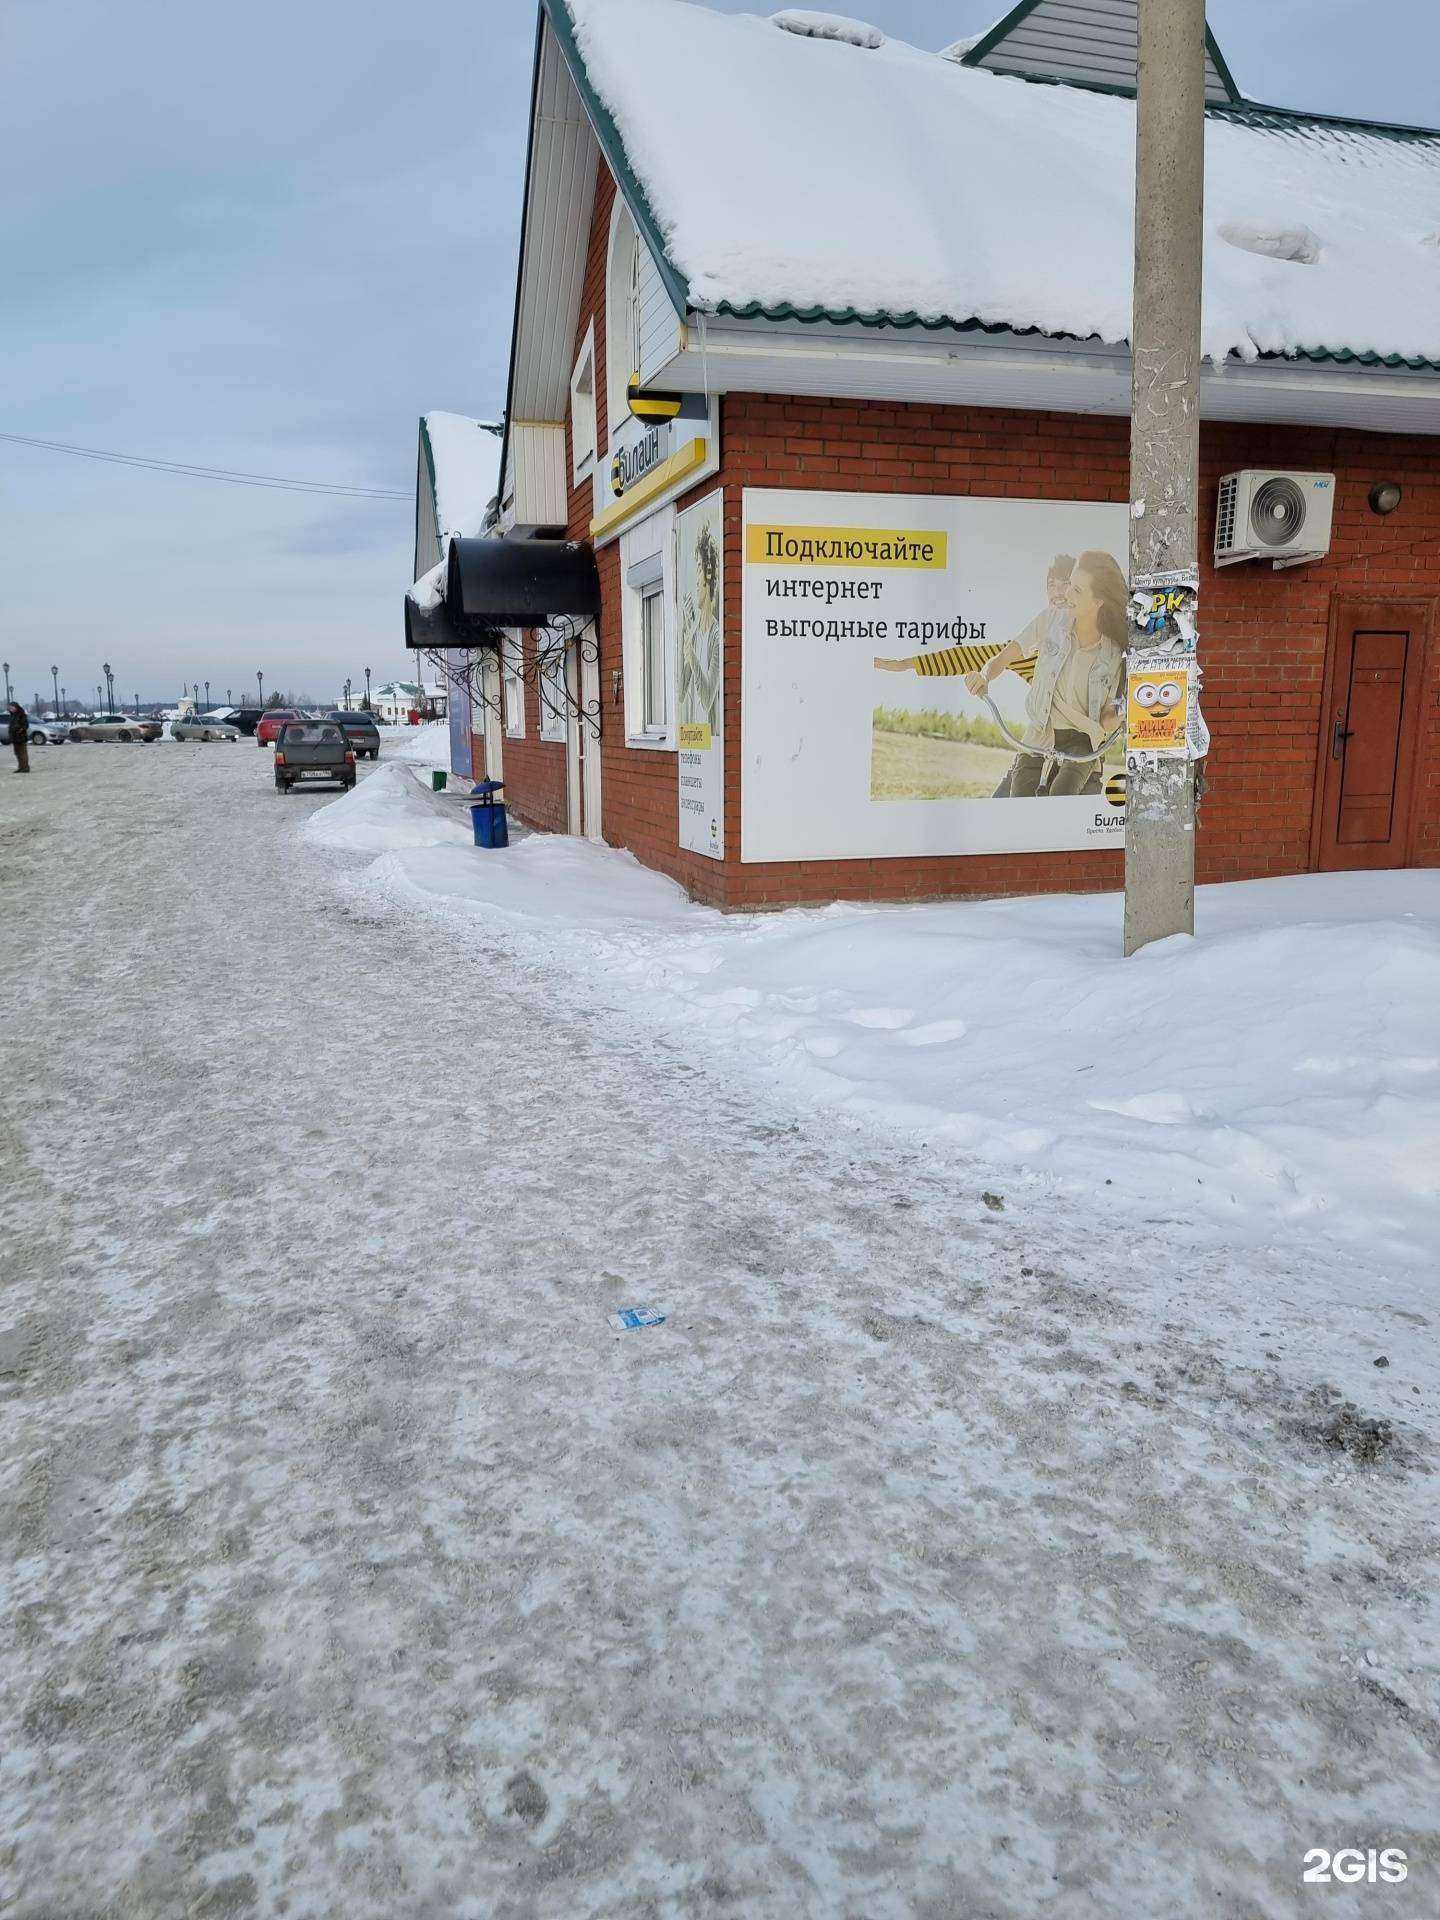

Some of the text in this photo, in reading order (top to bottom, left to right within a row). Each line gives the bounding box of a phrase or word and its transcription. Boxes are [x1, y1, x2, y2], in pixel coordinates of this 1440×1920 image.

[765, 531, 935, 561] Подключайте
[765, 578, 883, 604] интернет
[765, 615, 987, 645] выгодные тарифы
[1094, 813, 1126, 827] Била
